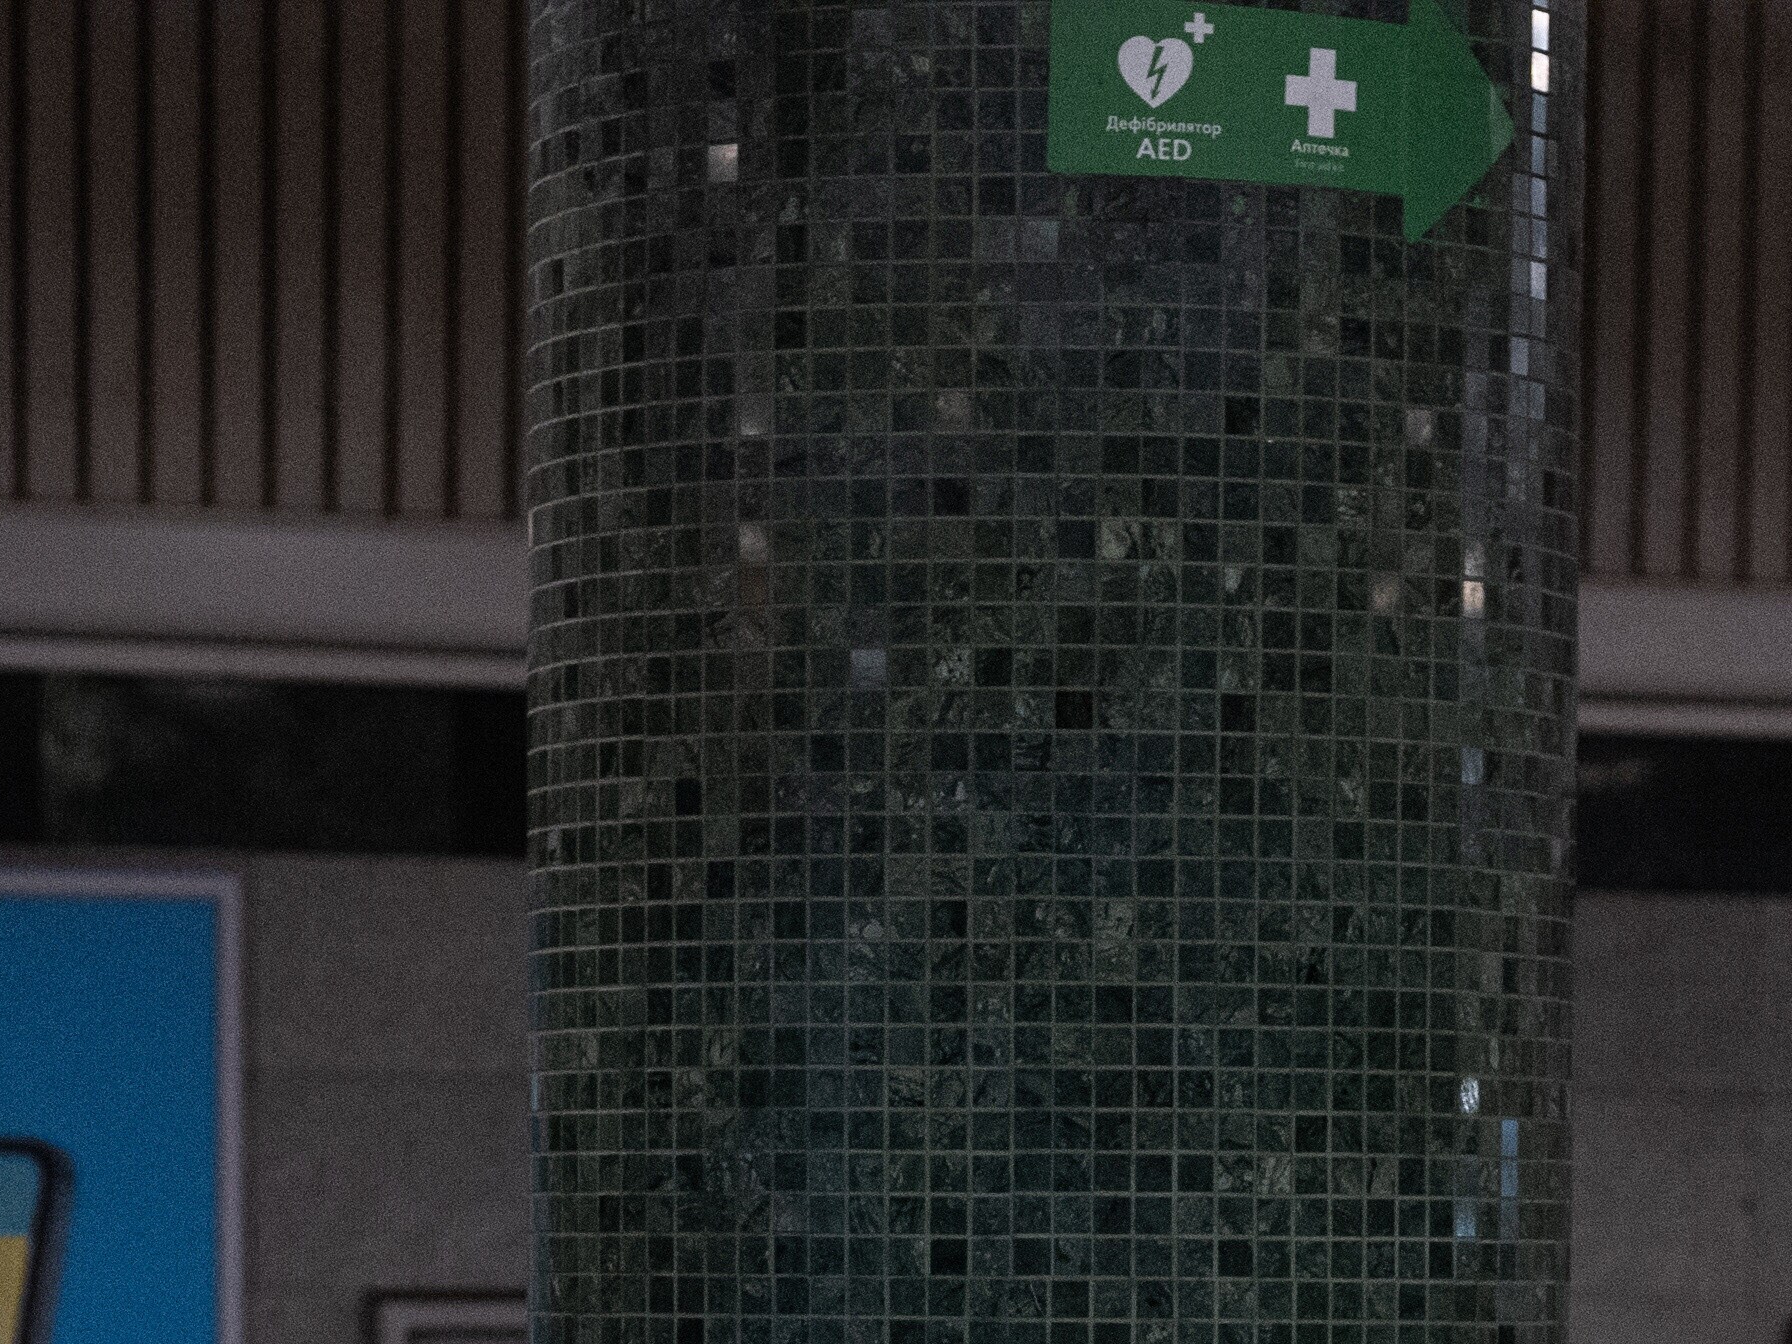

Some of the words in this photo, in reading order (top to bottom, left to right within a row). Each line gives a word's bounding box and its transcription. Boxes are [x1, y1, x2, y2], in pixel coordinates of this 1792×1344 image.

[1106, 115, 1222, 139] Дефібрилятор
[1136, 137, 1192, 161] AED
[1290, 139, 1350, 158] Аптечка
